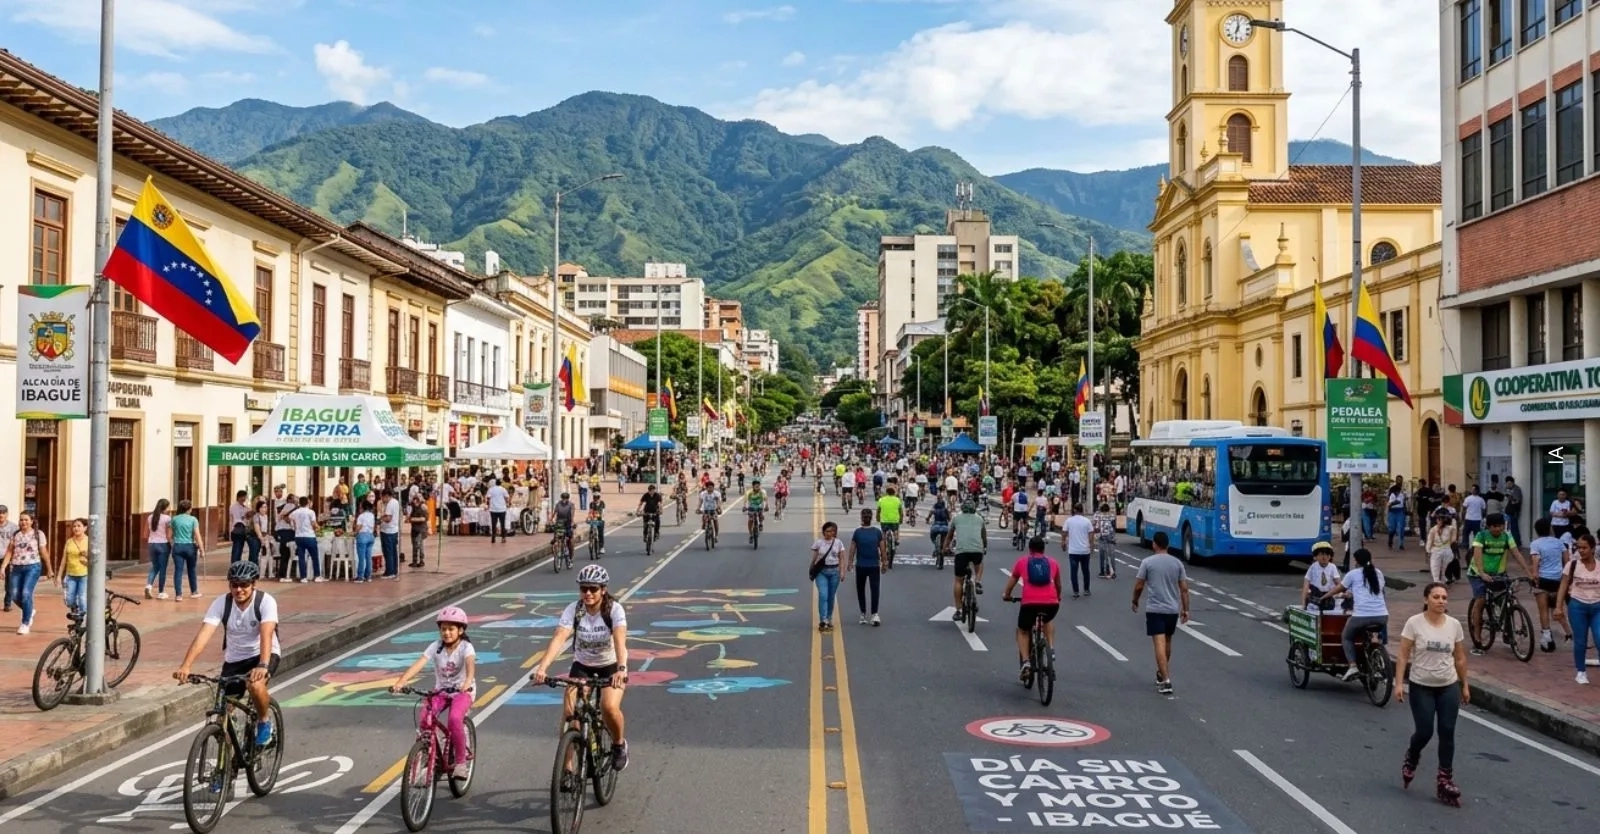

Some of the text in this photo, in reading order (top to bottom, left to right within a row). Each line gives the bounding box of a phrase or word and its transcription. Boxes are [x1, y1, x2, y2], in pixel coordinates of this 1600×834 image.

[1494, 369, 1583, 396] COOPERATIVA
[21, 385, 81, 401] IBAGUÉ
[282, 404, 362, 422] IBAGUÉ
[1331, 407, 1383, 417] PEDALEA
[278, 424, 361, 436] RESPIRA
[221, 450, 260, 461] IBAGUÉ
[262, 452, 304, 461] RESPIRA
[312, 450, 331, 461] DÍA
[332, 452, 349, 461] SIN
[351, 452, 387, 461] CARRO
[970, 755, 1167, 773] DÍA SIN
[978, 774, 1181, 791] CARRO
[985, 792, 1199, 809] Y MOTO
[1027, 810, 1221, 829] IBAGUÉ
